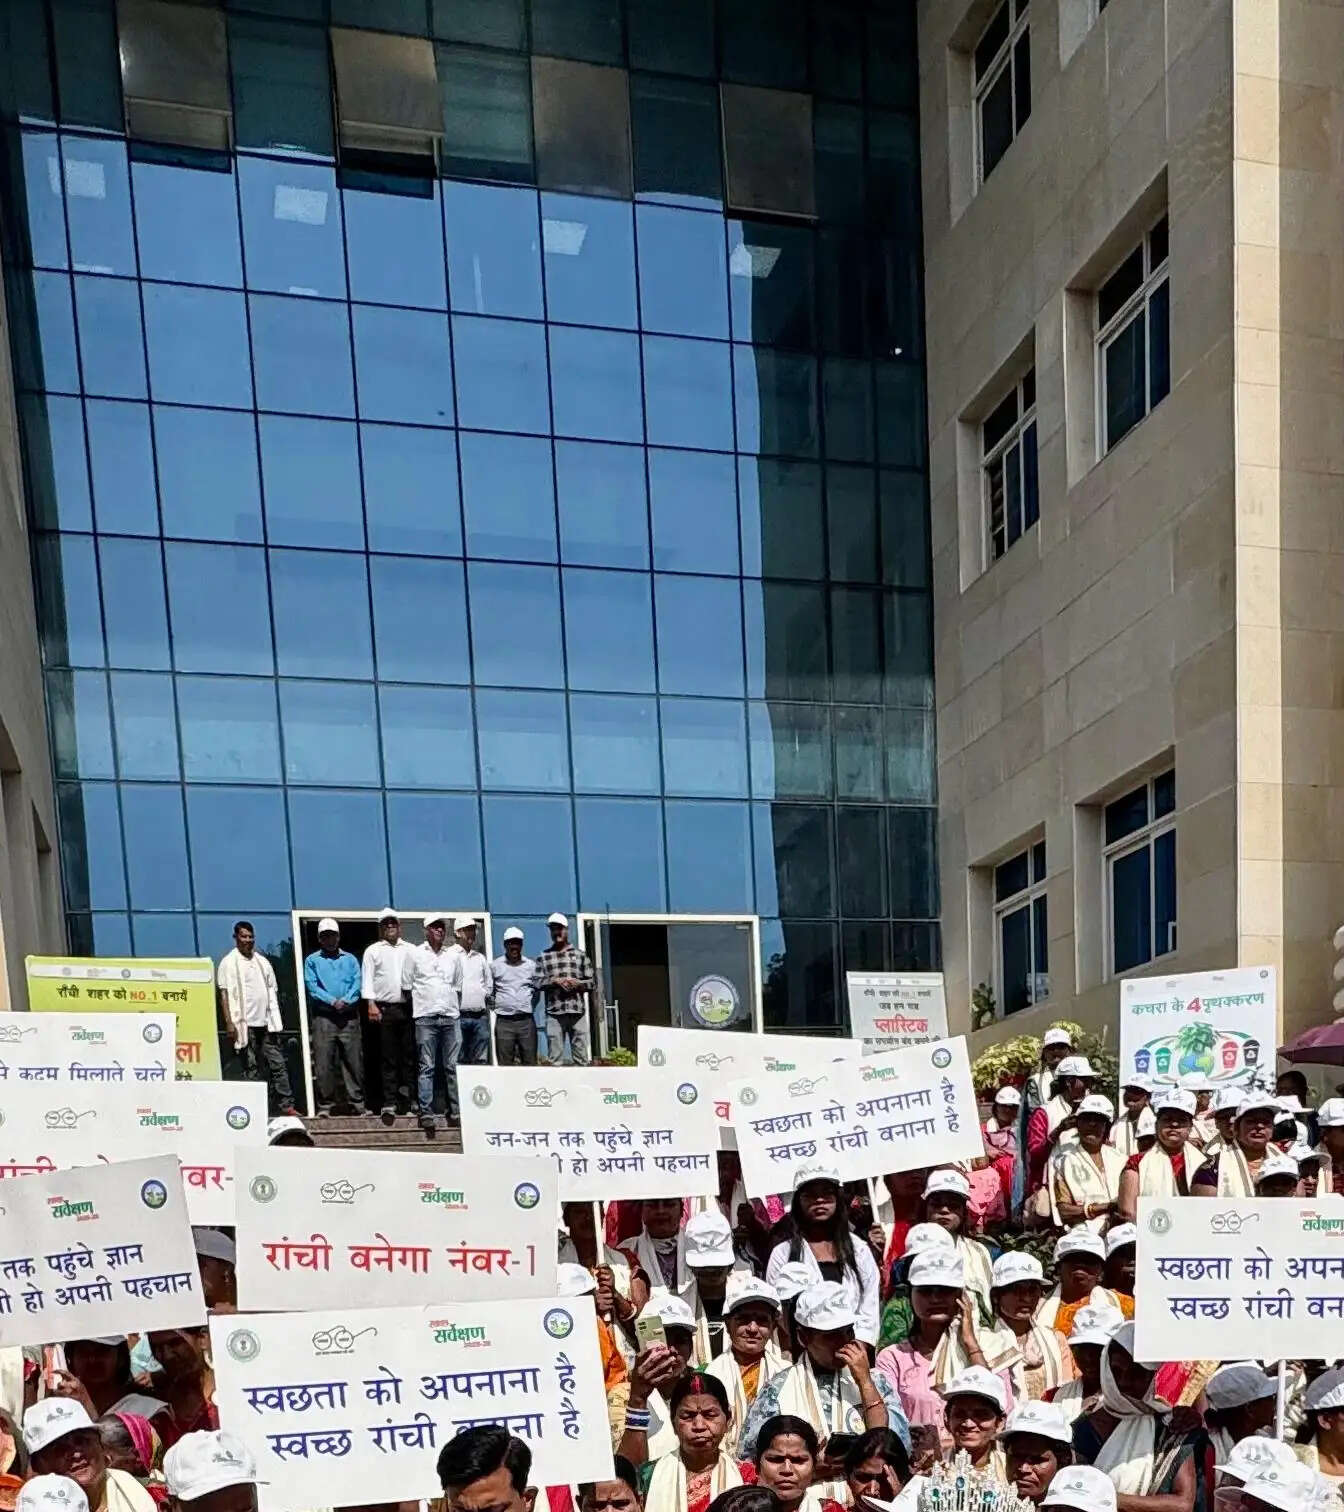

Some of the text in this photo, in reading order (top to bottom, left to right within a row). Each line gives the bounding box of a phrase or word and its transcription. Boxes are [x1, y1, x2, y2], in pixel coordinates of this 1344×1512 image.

[873, 1013, 929, 1033] प्लास्टिक
[1131, 1002, 1167, 1015] कचरा
[1170, 997, 1185, 1011] के
[1186, 996, 1202, 1012] 4
[68, 1059, 124, 1082] मिलाते
[133, 1060, 168, 1082] चले
[748, 1110, 812, 1137] स्वछता
[820, 1099, 847, 1124] को
[854, 1088, 933, 1118] अपनाना
[940, 1076, 956, 1104] है
[485, 1123, 674, 1153] जन-जन तक पहुंचे ज्ञान
[766, 1138, 817, 1163] स्वच्छ
[826, 1125, 869, 1153] रांची
[943, 1106, 961, 1133] है
[571, 1151, 588, 1176] हो
[597, 1151, 646, 1173] अपनी
[653, 1154, 711, 1174] पहचान
[0, 1242, 144, 1282] तक पहुंचे ज्ञान
[261, 1233, 334, 1272] रांची
[1154, 1256, 1233, 1281] स्वछता
[1243, 1246, 1273, 1280] को
[21, 1283, 44, 1314] हो
[55, 1275, 113, 1307] अपनी
[121, 1271, 193, 1298] पहचान
[1167, 1296, 1231, 1321] स्वच्छ
[1242, 1288, 1296, 1321] रांची
[433, 1322, 487, 1345] सर्वेक्षण
[242, 1352, 577, 1416] स्वछता को अपनाना है
[266, 1397, 581, 1462] स्वच्छ रांची है
